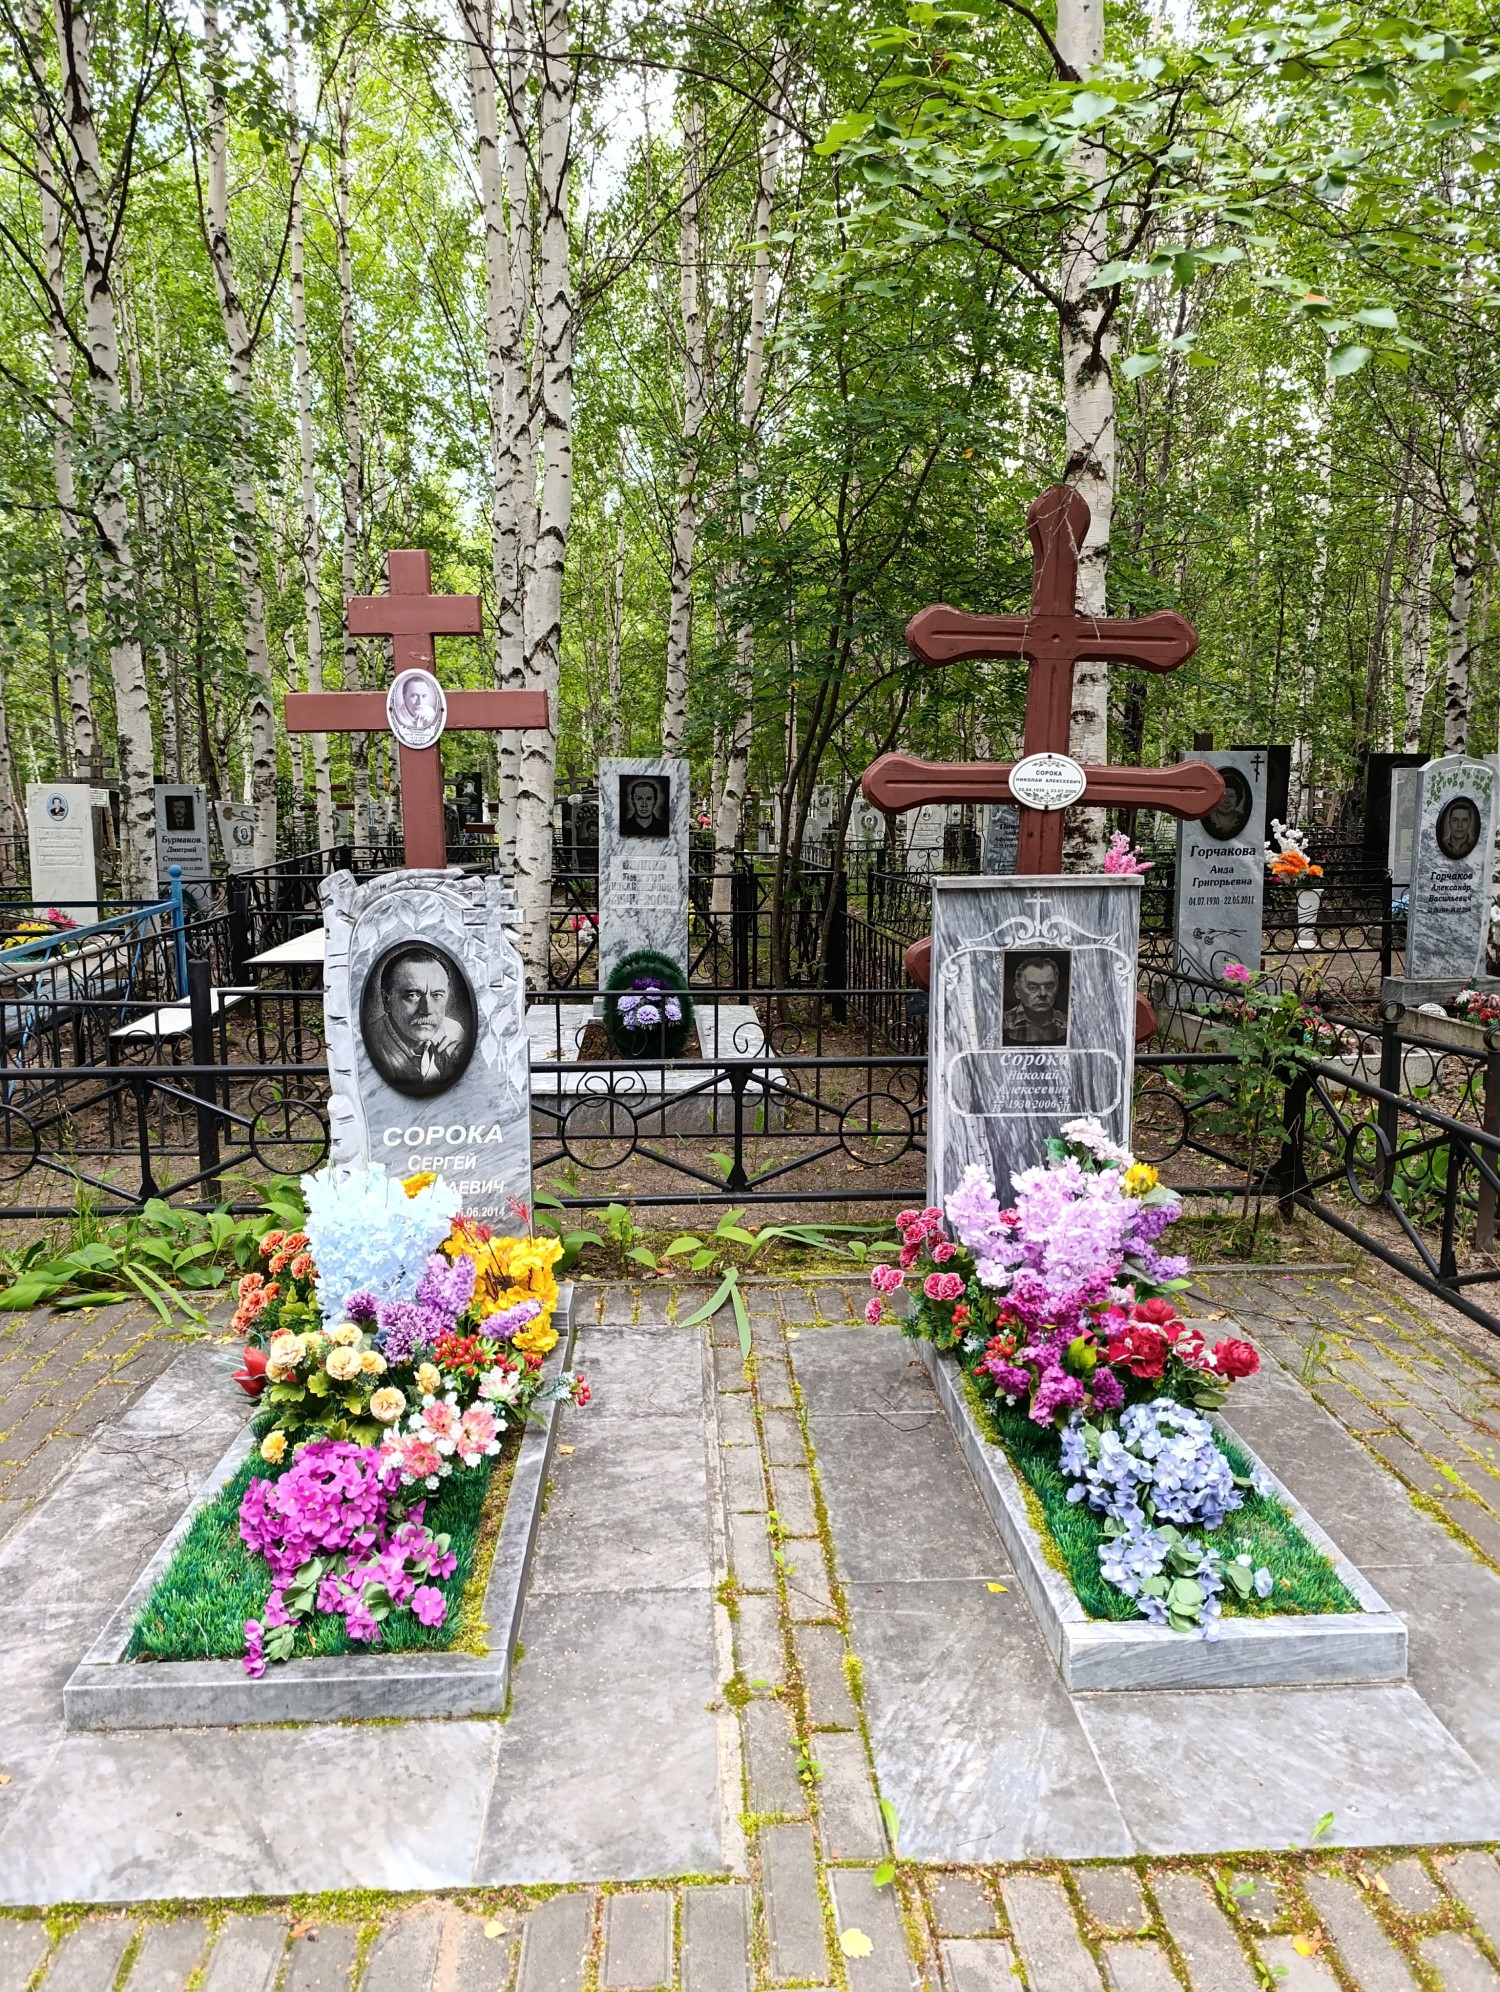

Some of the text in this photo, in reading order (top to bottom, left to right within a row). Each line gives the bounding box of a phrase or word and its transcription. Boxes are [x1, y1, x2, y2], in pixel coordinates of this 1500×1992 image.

[161, 836, 202, 844] Бурмаков
[1190, 845, 1256, 859] Горчакова
[1210, 865, 1234, 875] Аида
[1430, 871, 1473, 882] Горчаков
[1192, 878, 1253, 888] Григорьевна
[1431, 883, 1471, 892] Александр
[1189, 896, 1254, 906] 04.07.1930 22.05.2011
[1000, 1054, 1069, 1069] Сорока
[1008, 1070, 1059, 1080] Николай
[383, 1124, 504, 1147] СОРОКА
[446, 1180, 504, 1195] АЕВИЧ
